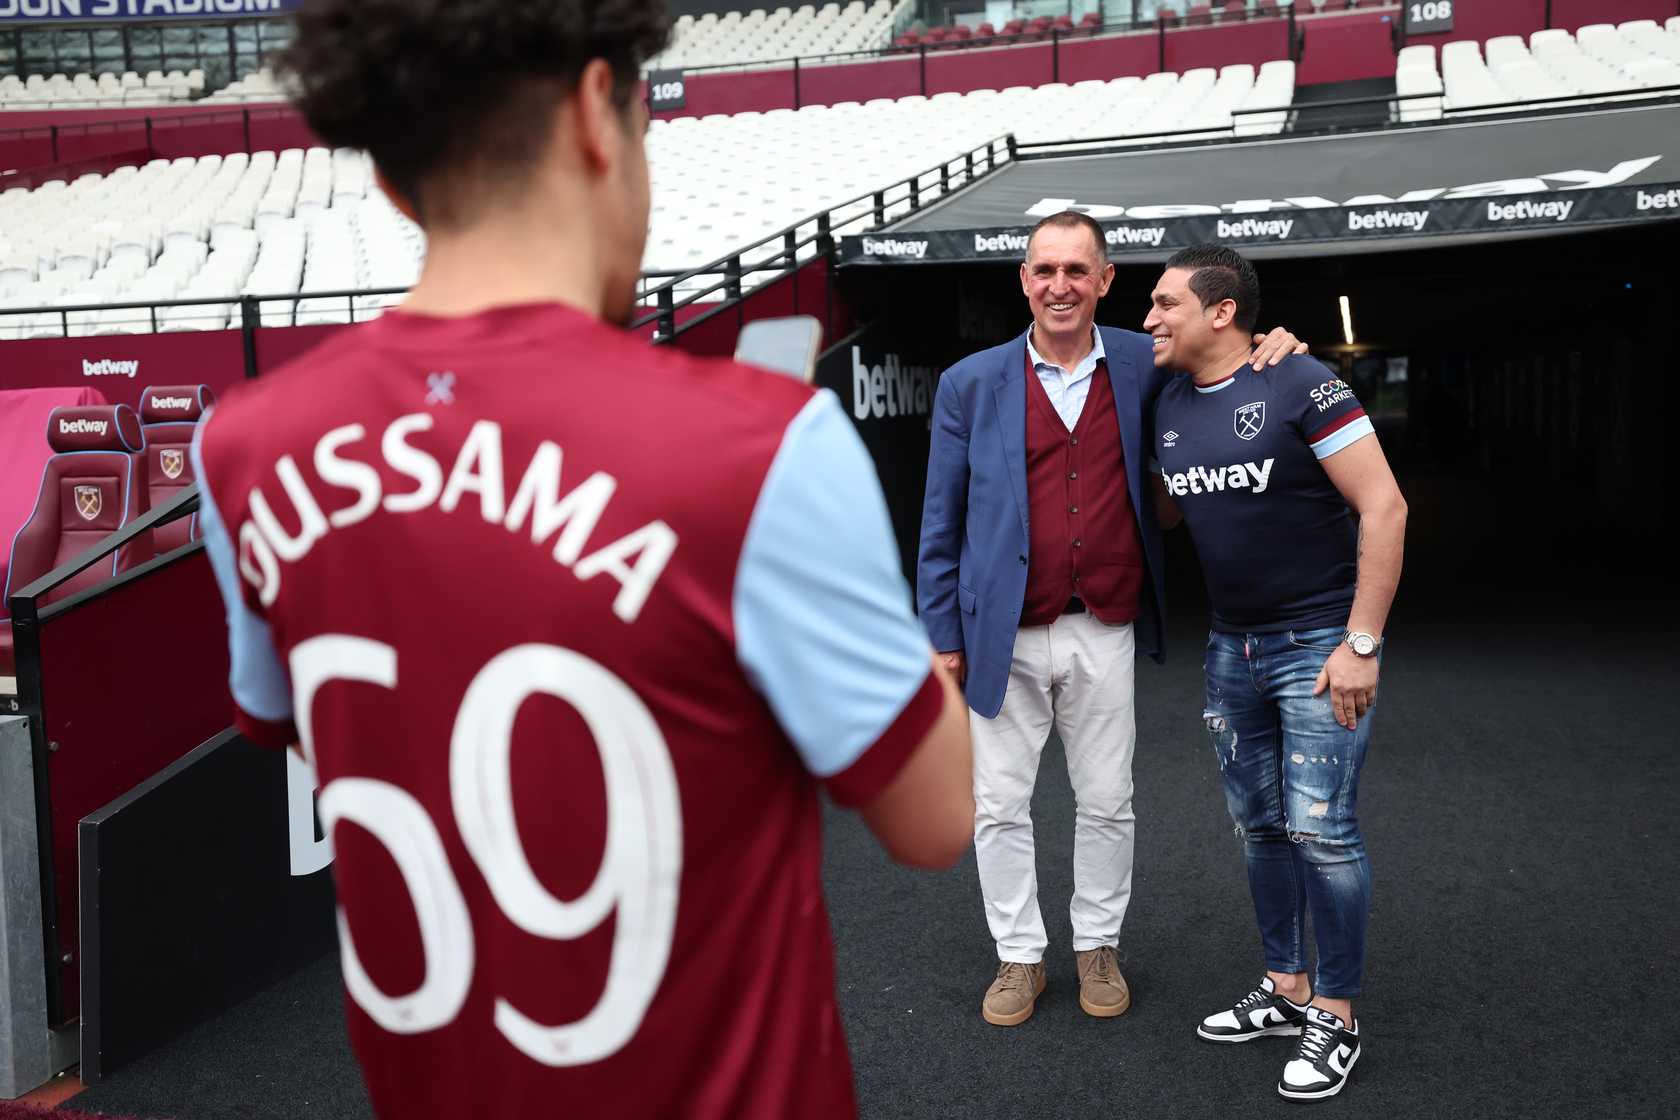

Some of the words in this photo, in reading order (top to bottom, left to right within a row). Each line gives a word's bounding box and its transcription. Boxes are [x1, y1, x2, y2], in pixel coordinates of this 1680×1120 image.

[1410, 0, 1452, 22] 108
[652, 82, 684, 101] 109
[1348, 210, 1429, 231] betway
[1487, 201, 1574, 221] betway
[1104, 227, 1166, 246] etway
[1217, 219, 1294, 238] betway
[862, 238, 929, 258] betway
[974, 234, 1028, 252] betwa
[82, 359, 139, 377] betway
[151, 395, 193, 411] betway
[59, 418, 108, 436] betway
[288, 634, 683, 1066] 69
